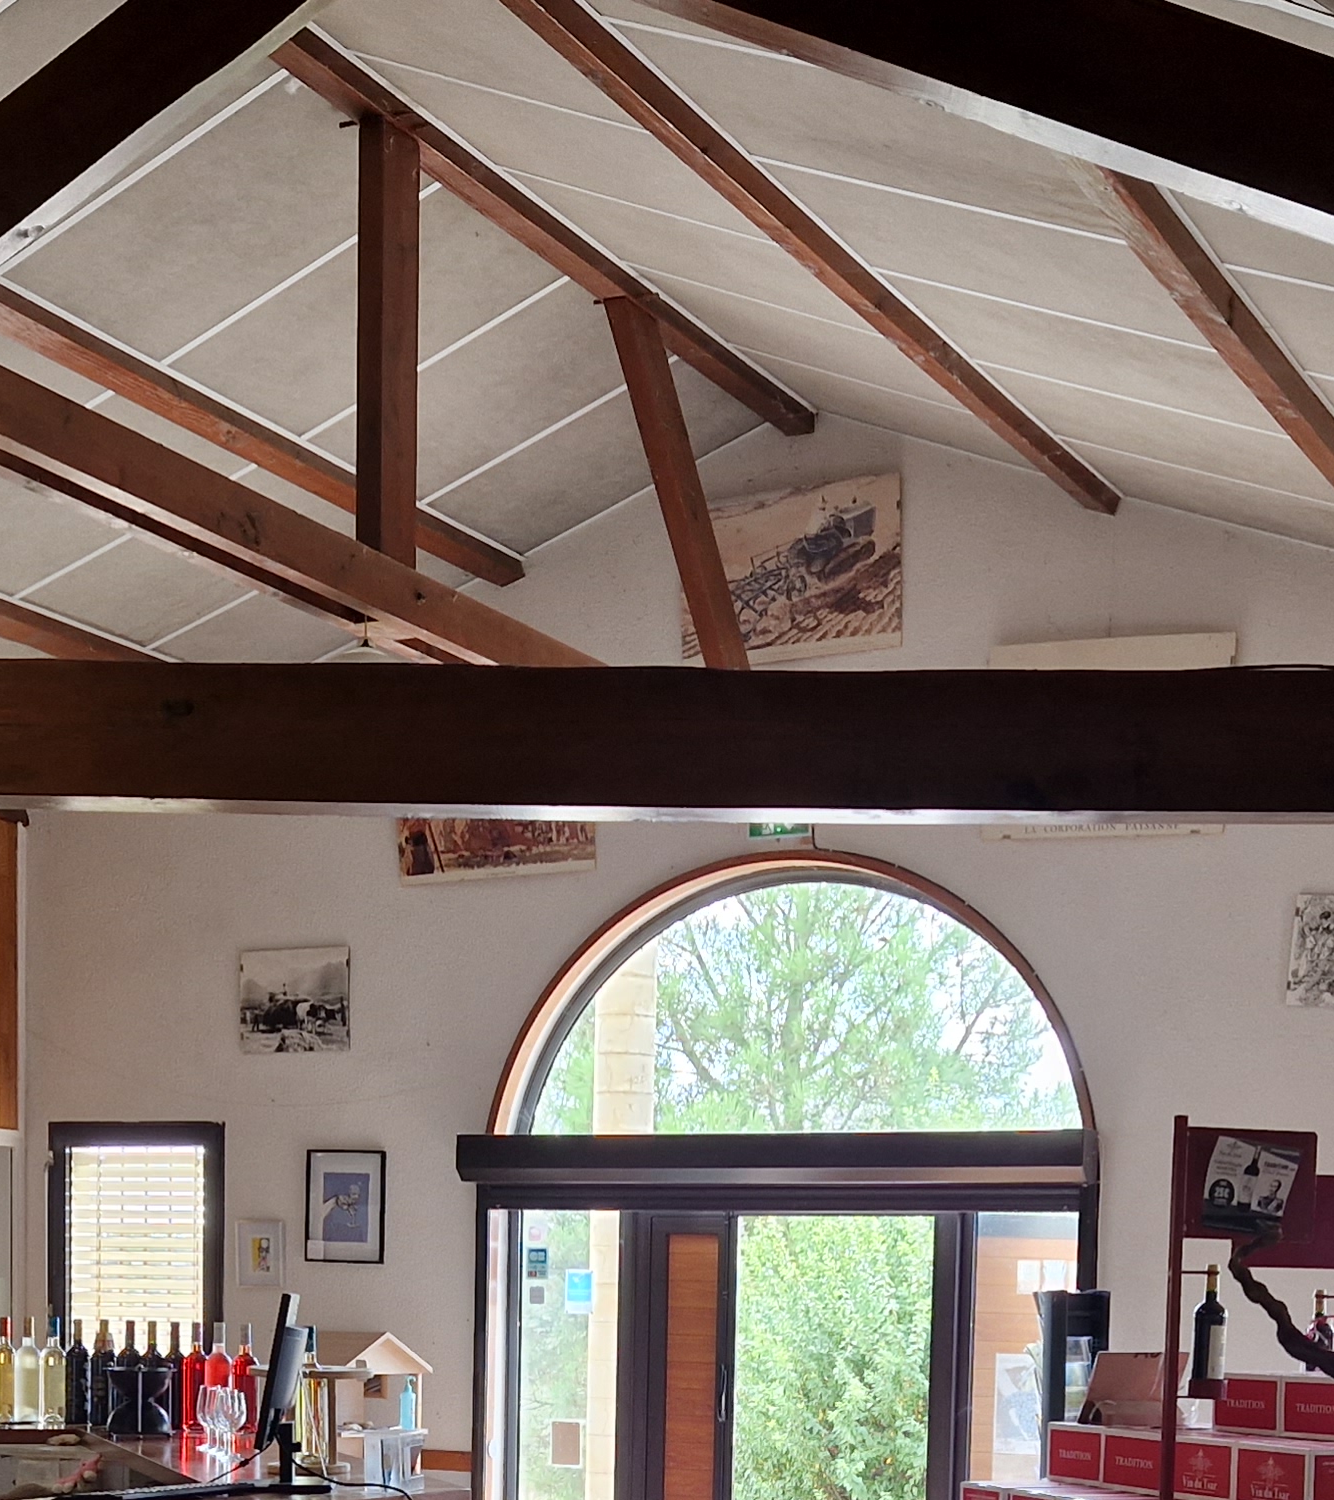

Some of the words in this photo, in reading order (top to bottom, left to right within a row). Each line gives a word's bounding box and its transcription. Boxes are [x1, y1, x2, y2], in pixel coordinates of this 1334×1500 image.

[1226, 1399, 1266, 1410] TRADITION
[1058, 1448, 1092, 1461] TRADITION
[1114, 1456, 1154, 1469] TRADITION
[1182, 1475, 1194, 1488] Vin
[1194, 1477, 1202, 1489] du
[1203, 1478, 1218, 1491] Tsar
[1250, 1485, 1263, 1499] Vin
[1263, 1486, 1273, 1499] du
[1273, 1487, 1290, 1500] Tsar
